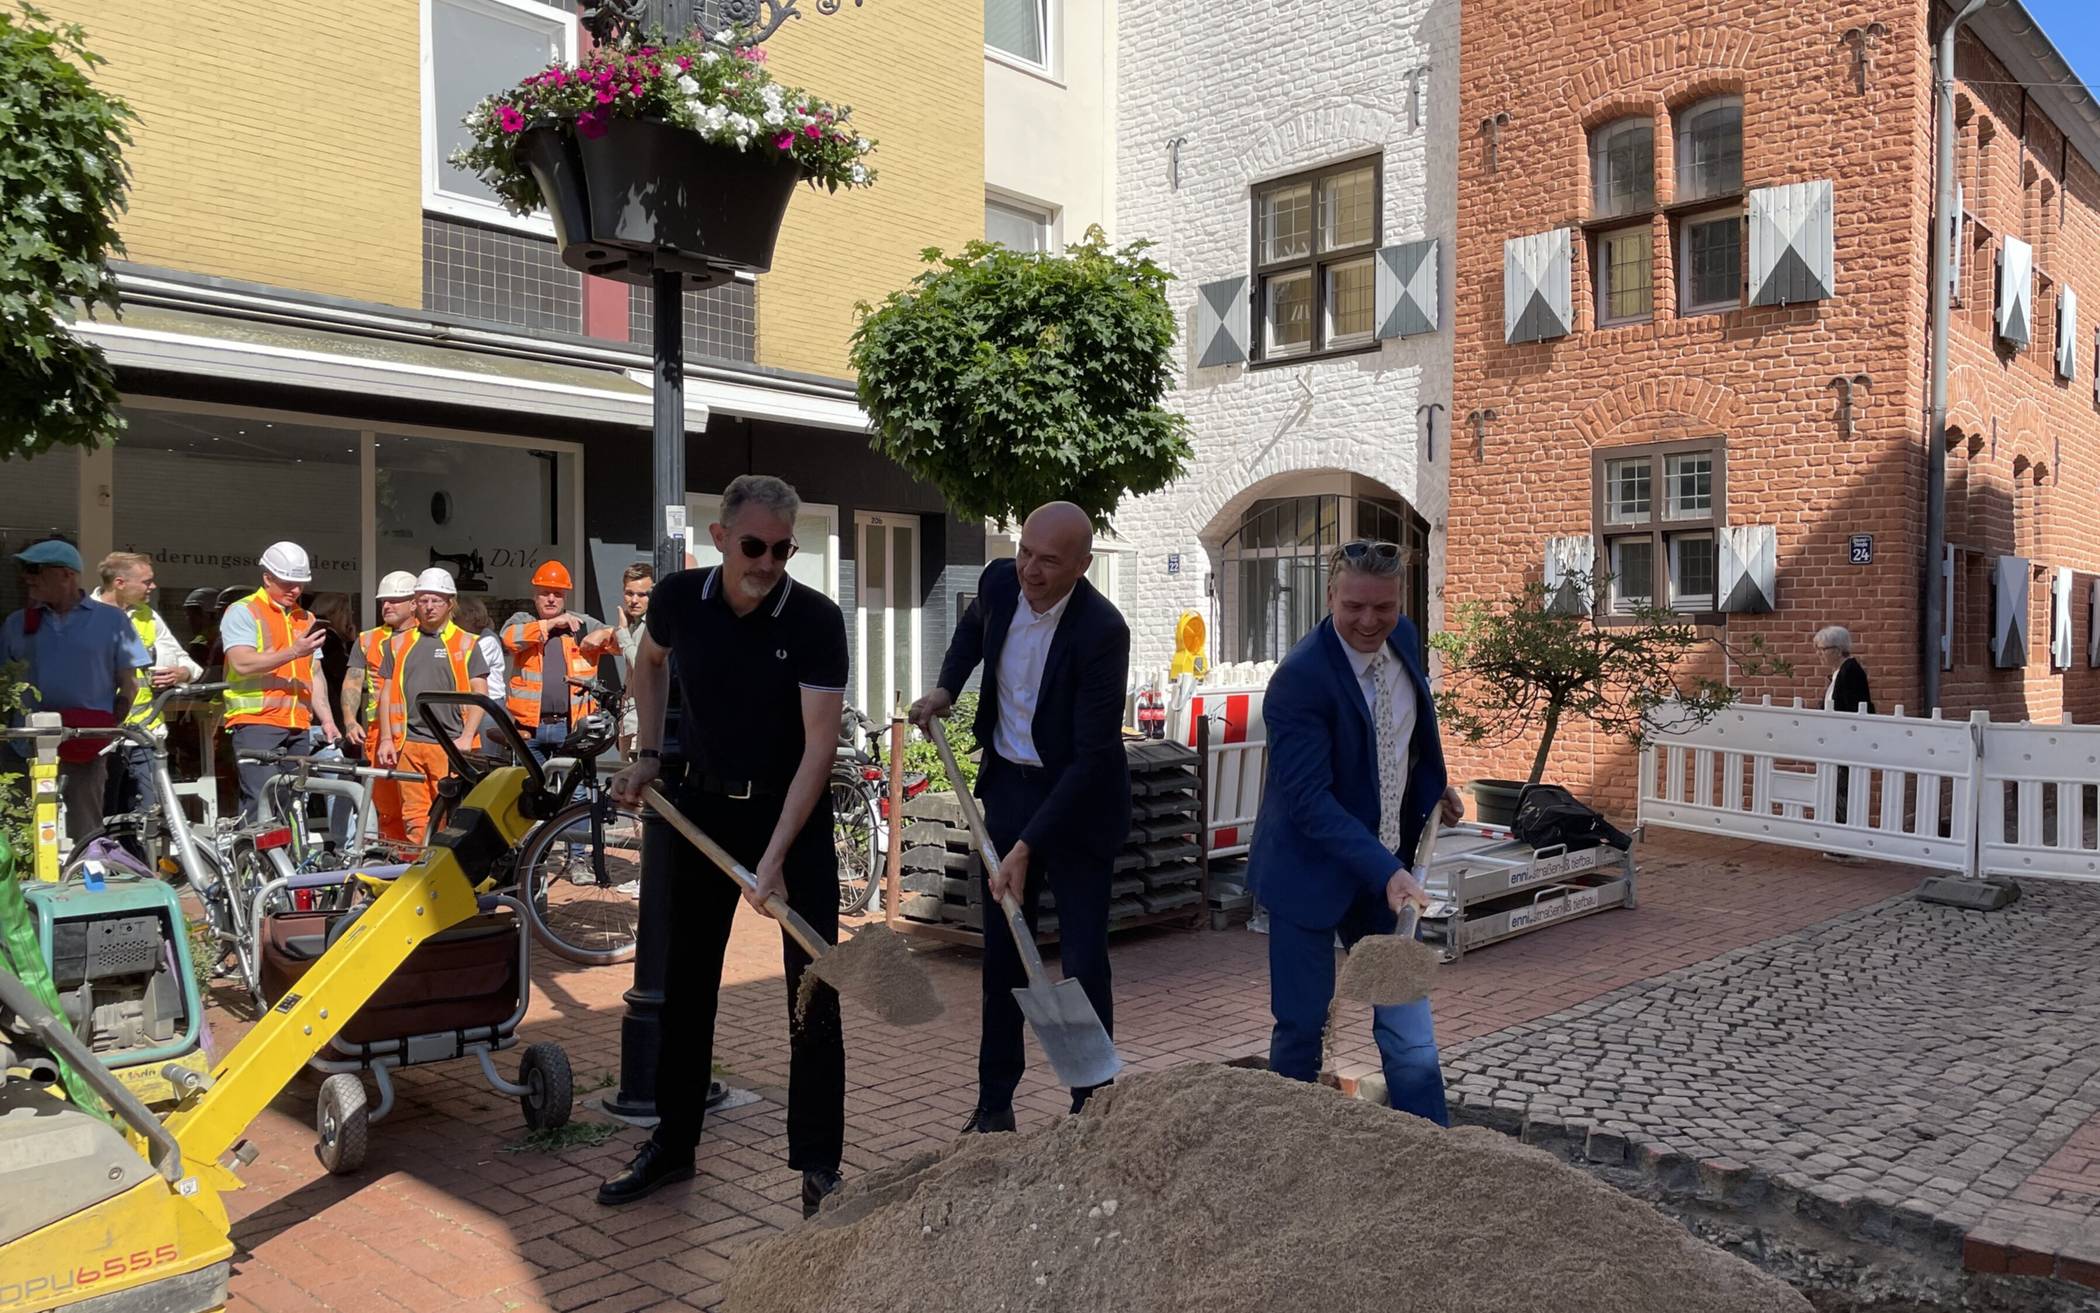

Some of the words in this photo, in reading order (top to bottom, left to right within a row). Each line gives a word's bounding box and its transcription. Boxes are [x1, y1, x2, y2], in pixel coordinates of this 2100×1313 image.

[490, 548, 538, 569] DiVe
[1853, 548, 1870, 561] 24
[1170, 562, 1178, 571] 22
